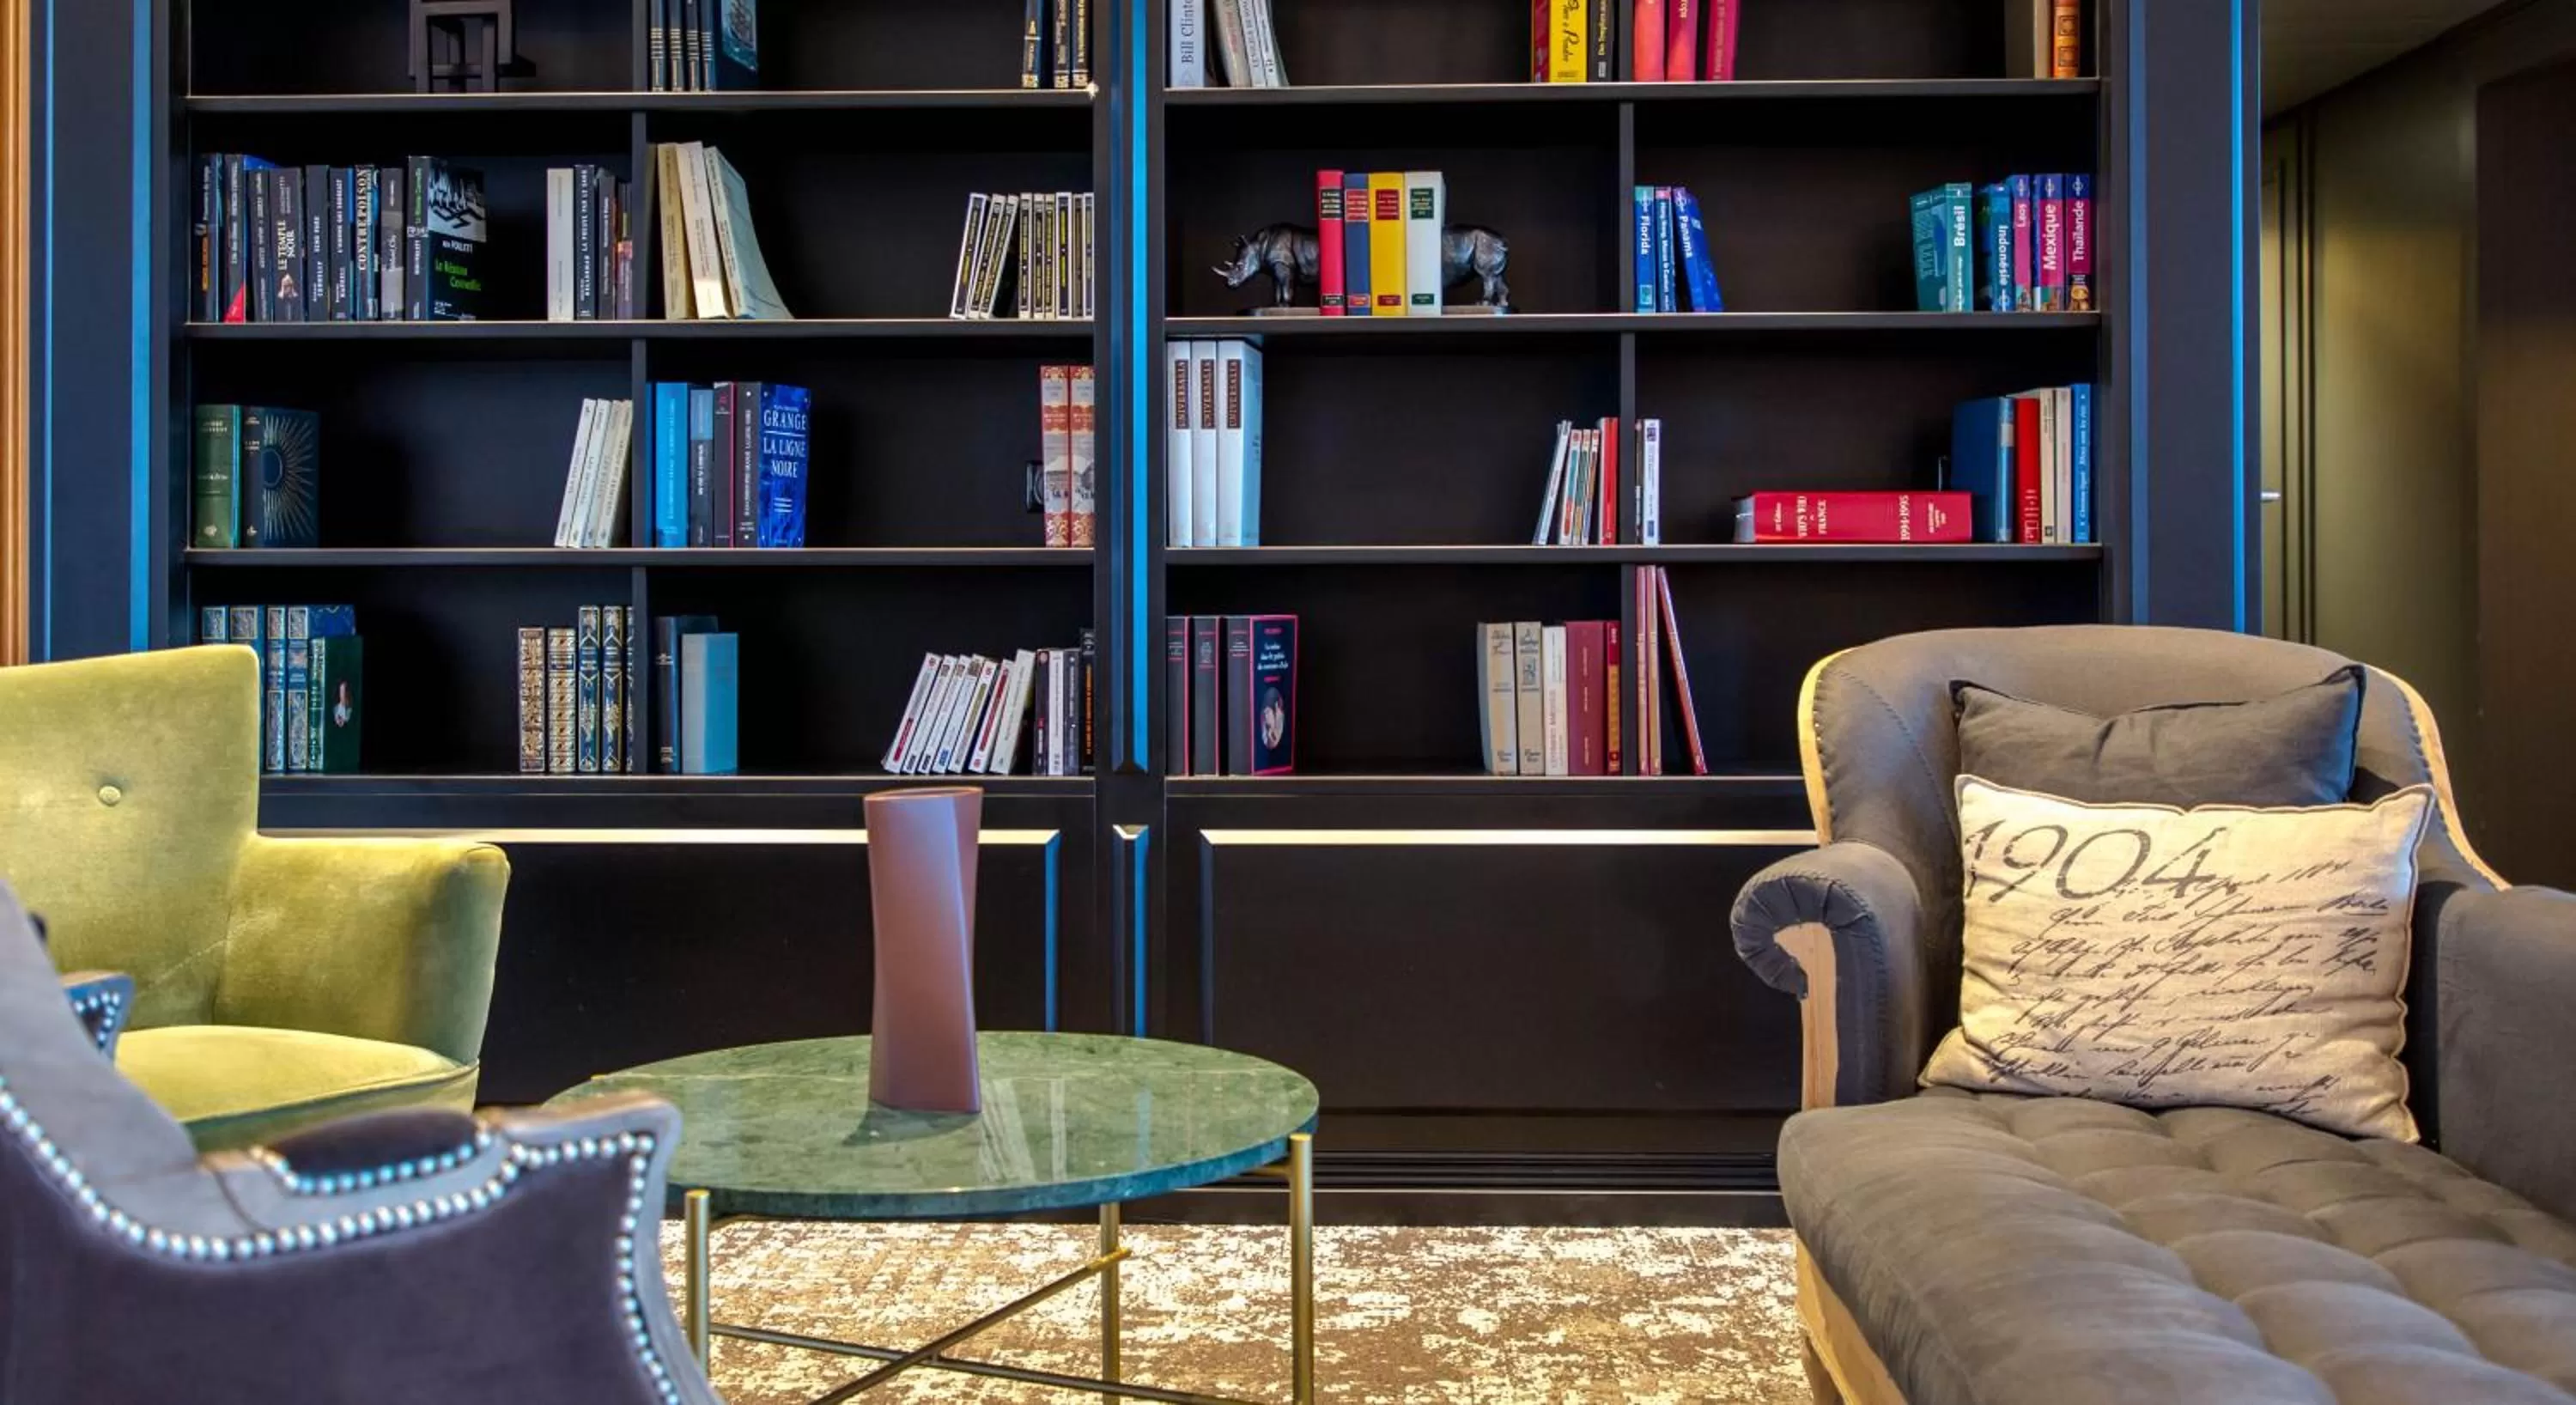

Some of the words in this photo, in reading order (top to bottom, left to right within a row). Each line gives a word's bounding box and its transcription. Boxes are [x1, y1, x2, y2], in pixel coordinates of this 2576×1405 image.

[1181, 40, 1194, 64] Bill
[356, 169, 367, 271] CONTREPOISON
[1641, 216, 1650, 255] Florida
[1953, 205, 1965, 247] Brésil
[2016, 204, 2026, 228] Laos
[2072, 200, 2085, 262] Thaïlande
[277, 219, 287, 258] TEMPLE
[286, 229, 296, 258] NOIR
[581, 242, 588, 252] LA
[1679, 216, 1692, 258] Panama
[1998, 225, 2010, 286] Indonésie
[2043, 204, 2060, 271] Mexique
[277, 258, 287, 271] LE
[763, 436, 776, 454] LA
[779, 439, 805, 458] LIGNE
[771, 459, 799, 478] NOIRE
[1964, 819, 2227, 903] 1904
